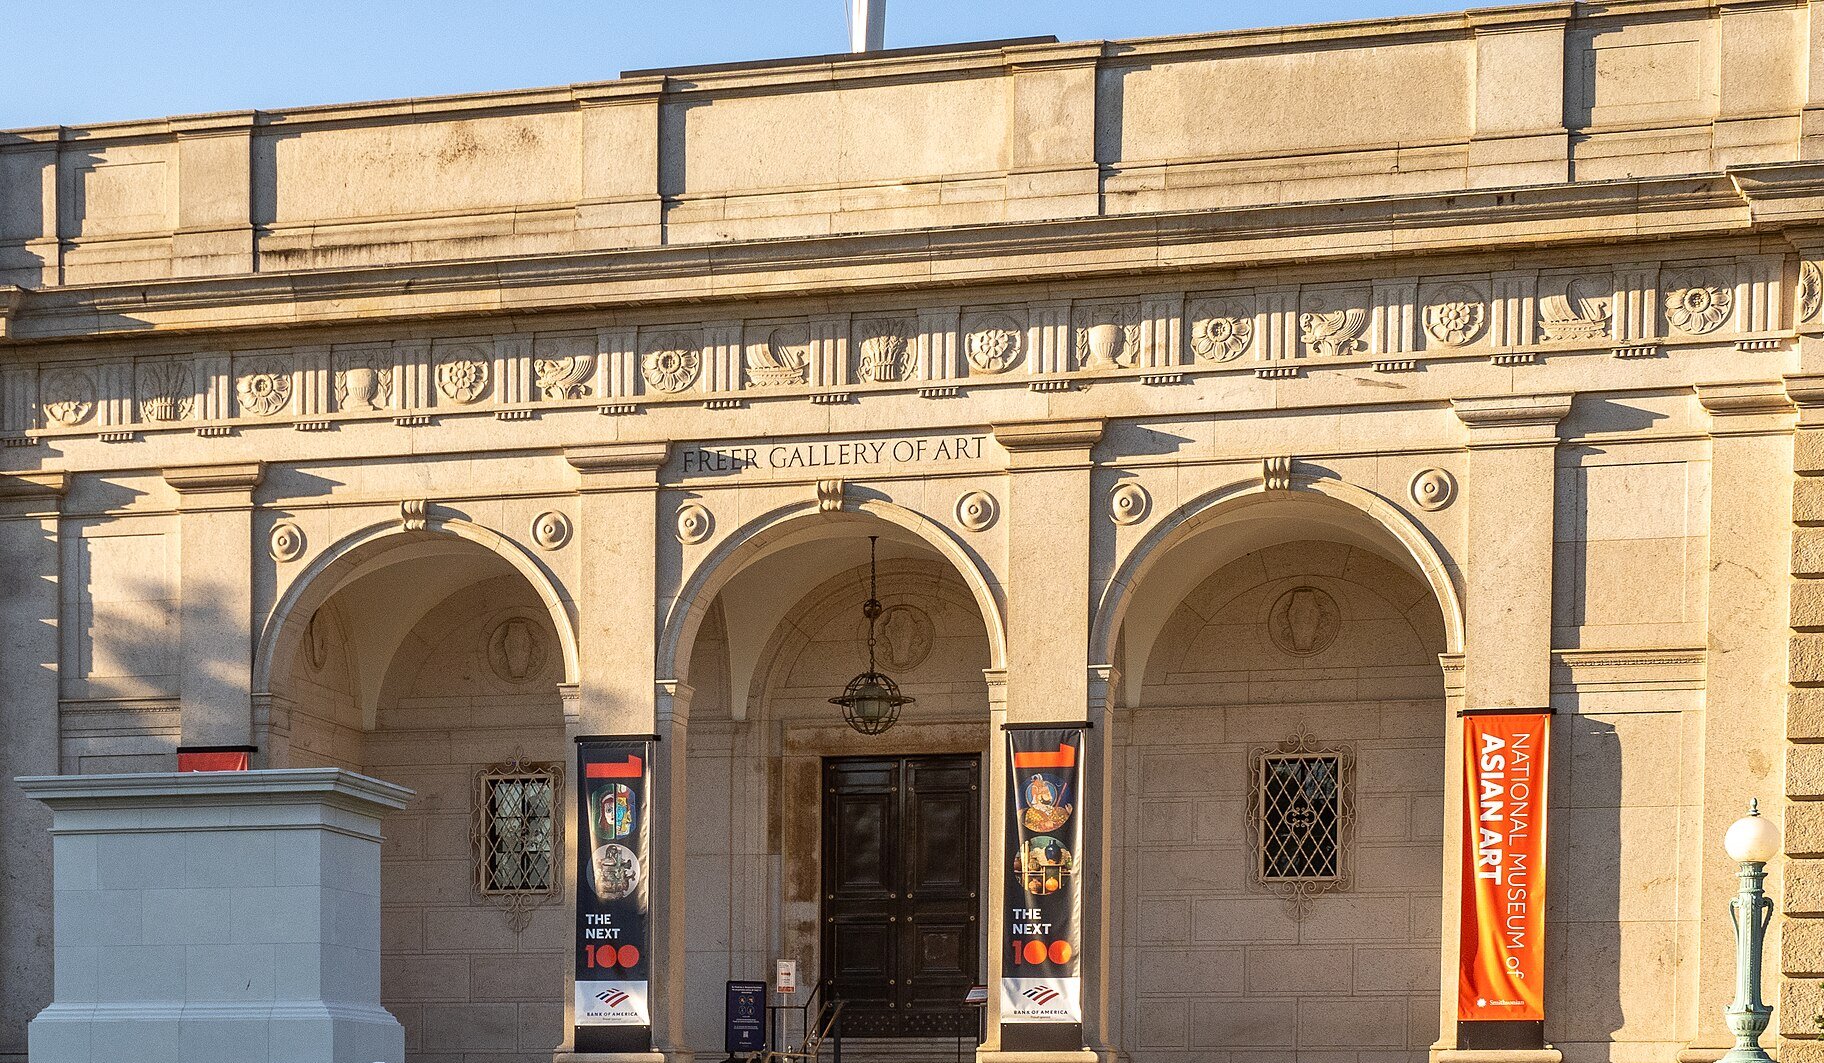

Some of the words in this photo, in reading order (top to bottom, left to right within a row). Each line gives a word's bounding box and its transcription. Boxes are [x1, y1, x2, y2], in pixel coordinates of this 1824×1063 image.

[682, 447, 762, 473] FREER
[769, 441, 886, 469] GALLERY
[893, 439, 928, 463] OF
[933, 436, 987, 461] ART
[1480, 732, 1506, 822] ASIAN
[1508, 733, 1531, 846] NATIONAL
[1478, 826, 1503, 886] ART
[1506, 853, 1527, 949] MUSEUM
[585, 913, 612, 925] THE
[1012, 908, 1042, 920] THE
[585, 928, 621, 939] NEXT
[1012, 923, 1052, 935] NEXT
[585, 944, 640, 969] 100
[1012, 939, 1073, 965] 100
[1505, 956, 1525, 979] of
